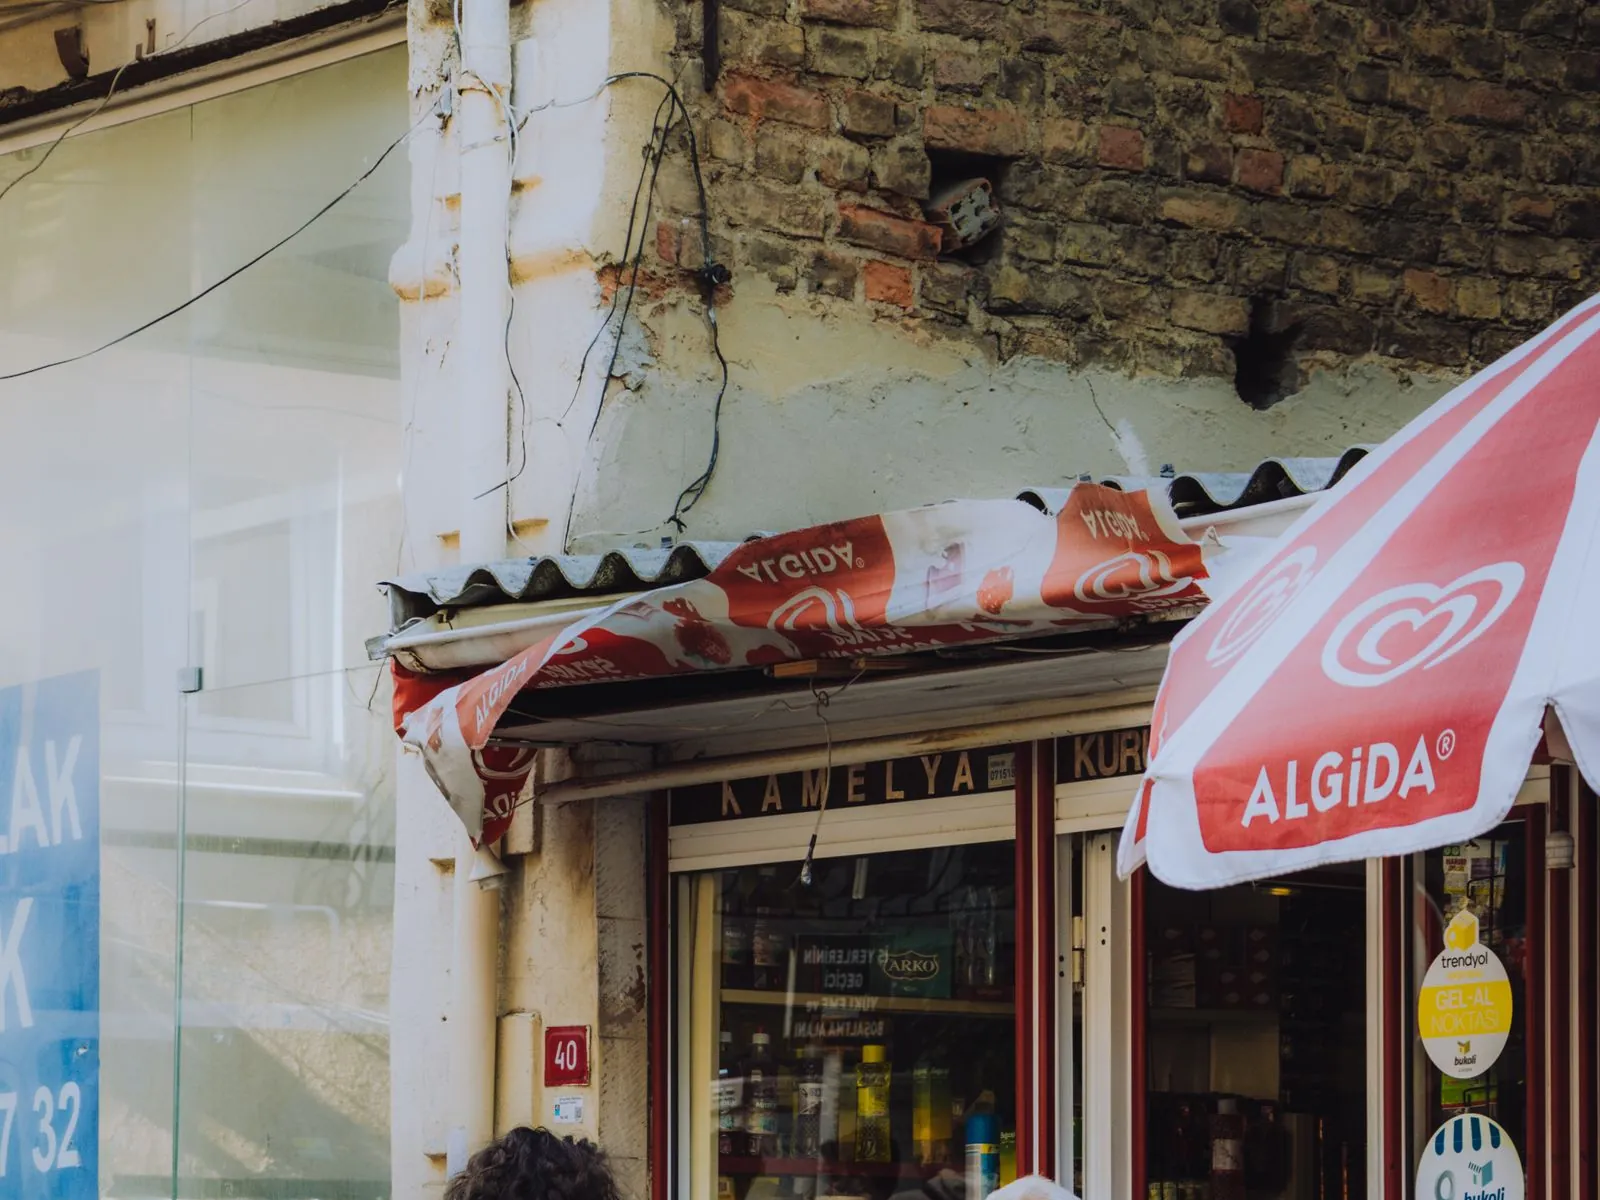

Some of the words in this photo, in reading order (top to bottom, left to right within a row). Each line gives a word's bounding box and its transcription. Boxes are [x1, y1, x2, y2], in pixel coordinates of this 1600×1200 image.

[0, 734, 83, 853] AK
[722, 752, 974, 816] KAMELYA
[889, 958, 934, 973] ARKO
[1441, 952, 1489, 969] trendyol
[1436, 988, 1494, 1011] GEL-AL
[1431, 1010, 1498, 1034] NOKTASI
[554, 1040, 577, 1070] 40
[1454, 1054, 1477, 1067] bukoli
[32, 1081, 82, 1173] 32
